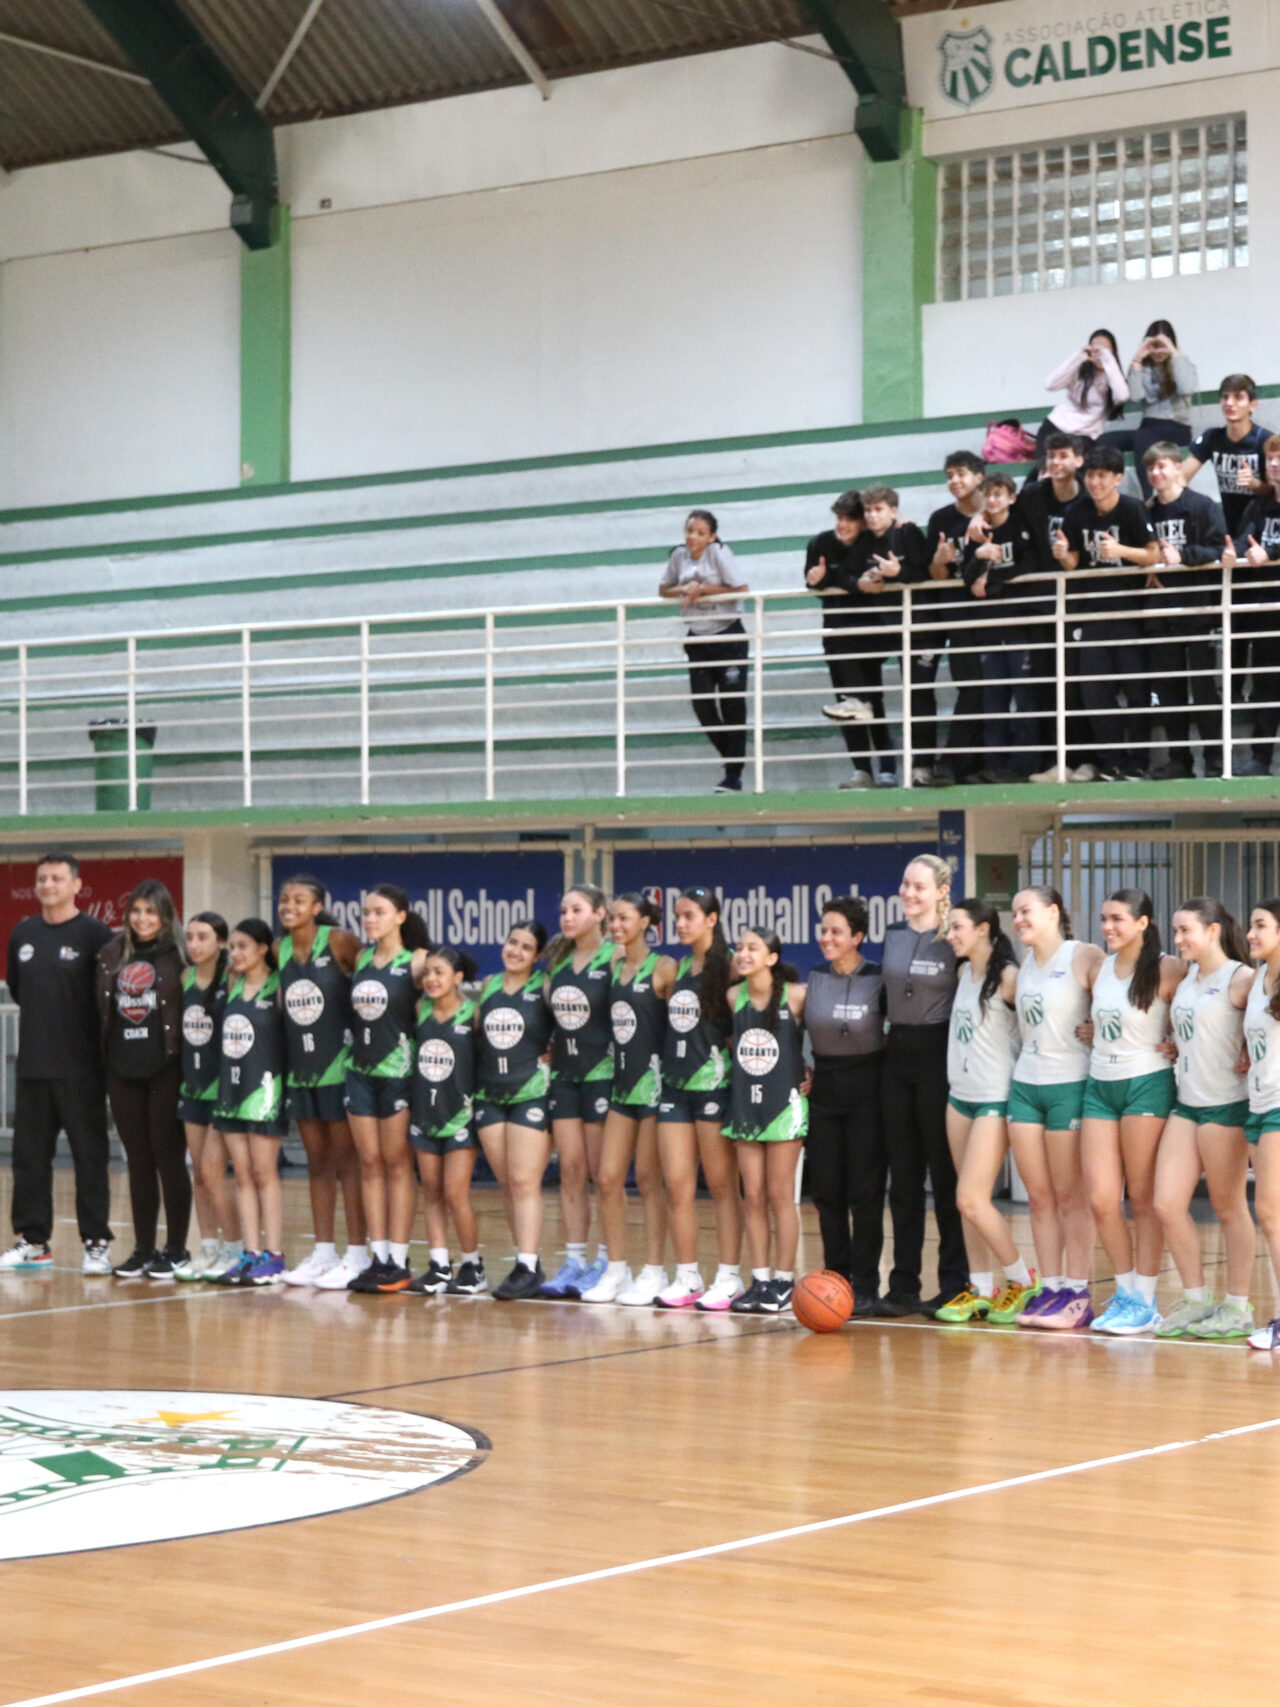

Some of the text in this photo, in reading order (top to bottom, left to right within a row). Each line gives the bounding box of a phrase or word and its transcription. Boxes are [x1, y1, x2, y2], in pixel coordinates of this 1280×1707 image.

[1004, 16, 1232, 88] CALDENSE
[448, 888, 534, 945] School
[498, 1057, 508, 1074] 11
[430, 1088, 438, 1106] 7
[751, 1084, 763, 1104] 15
